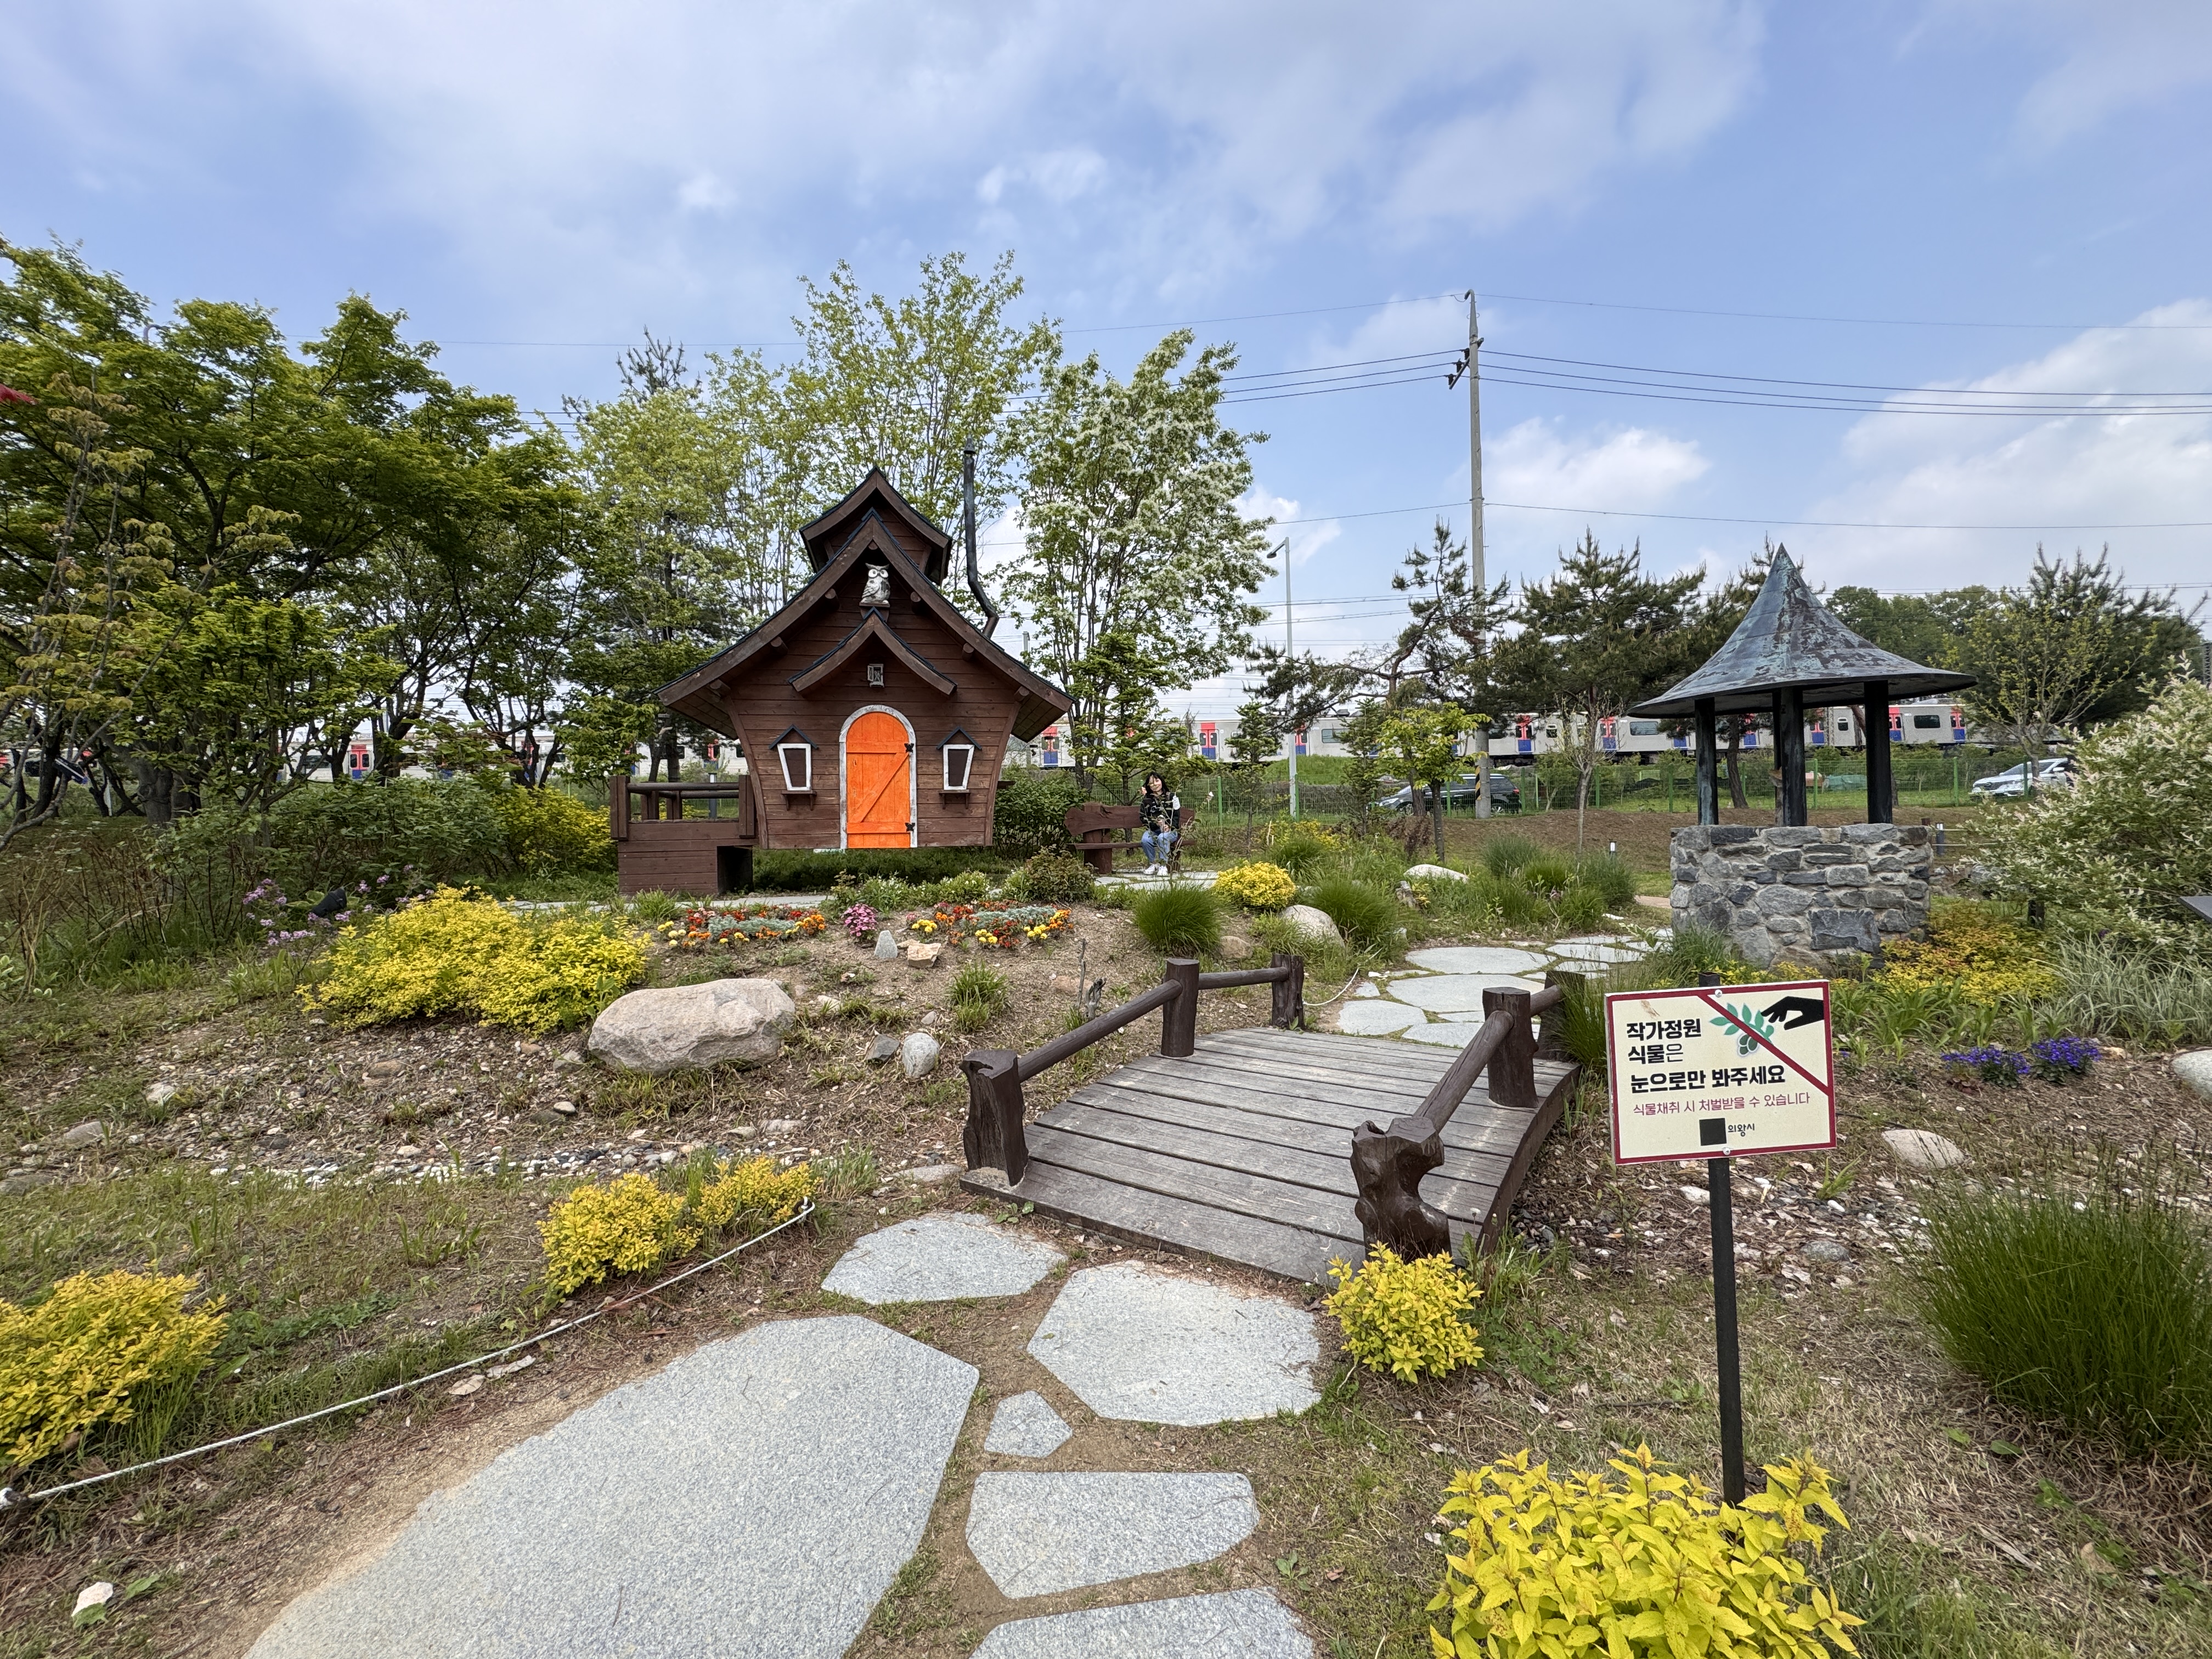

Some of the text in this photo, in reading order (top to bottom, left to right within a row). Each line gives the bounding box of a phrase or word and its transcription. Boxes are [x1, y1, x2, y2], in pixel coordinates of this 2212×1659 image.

[1627, 1018, 1701, 1041] 작가정원
[1628, 1043, 1683, 1064] 식물은
[1631, 1065, 1785, 1093] 눈으로만 봐주세요
[1633, 1092, 1810, 1116] 식물채취 시 처벌받을 수 있습니다
[1728, 1123, 1755, 1137] 의왕시
